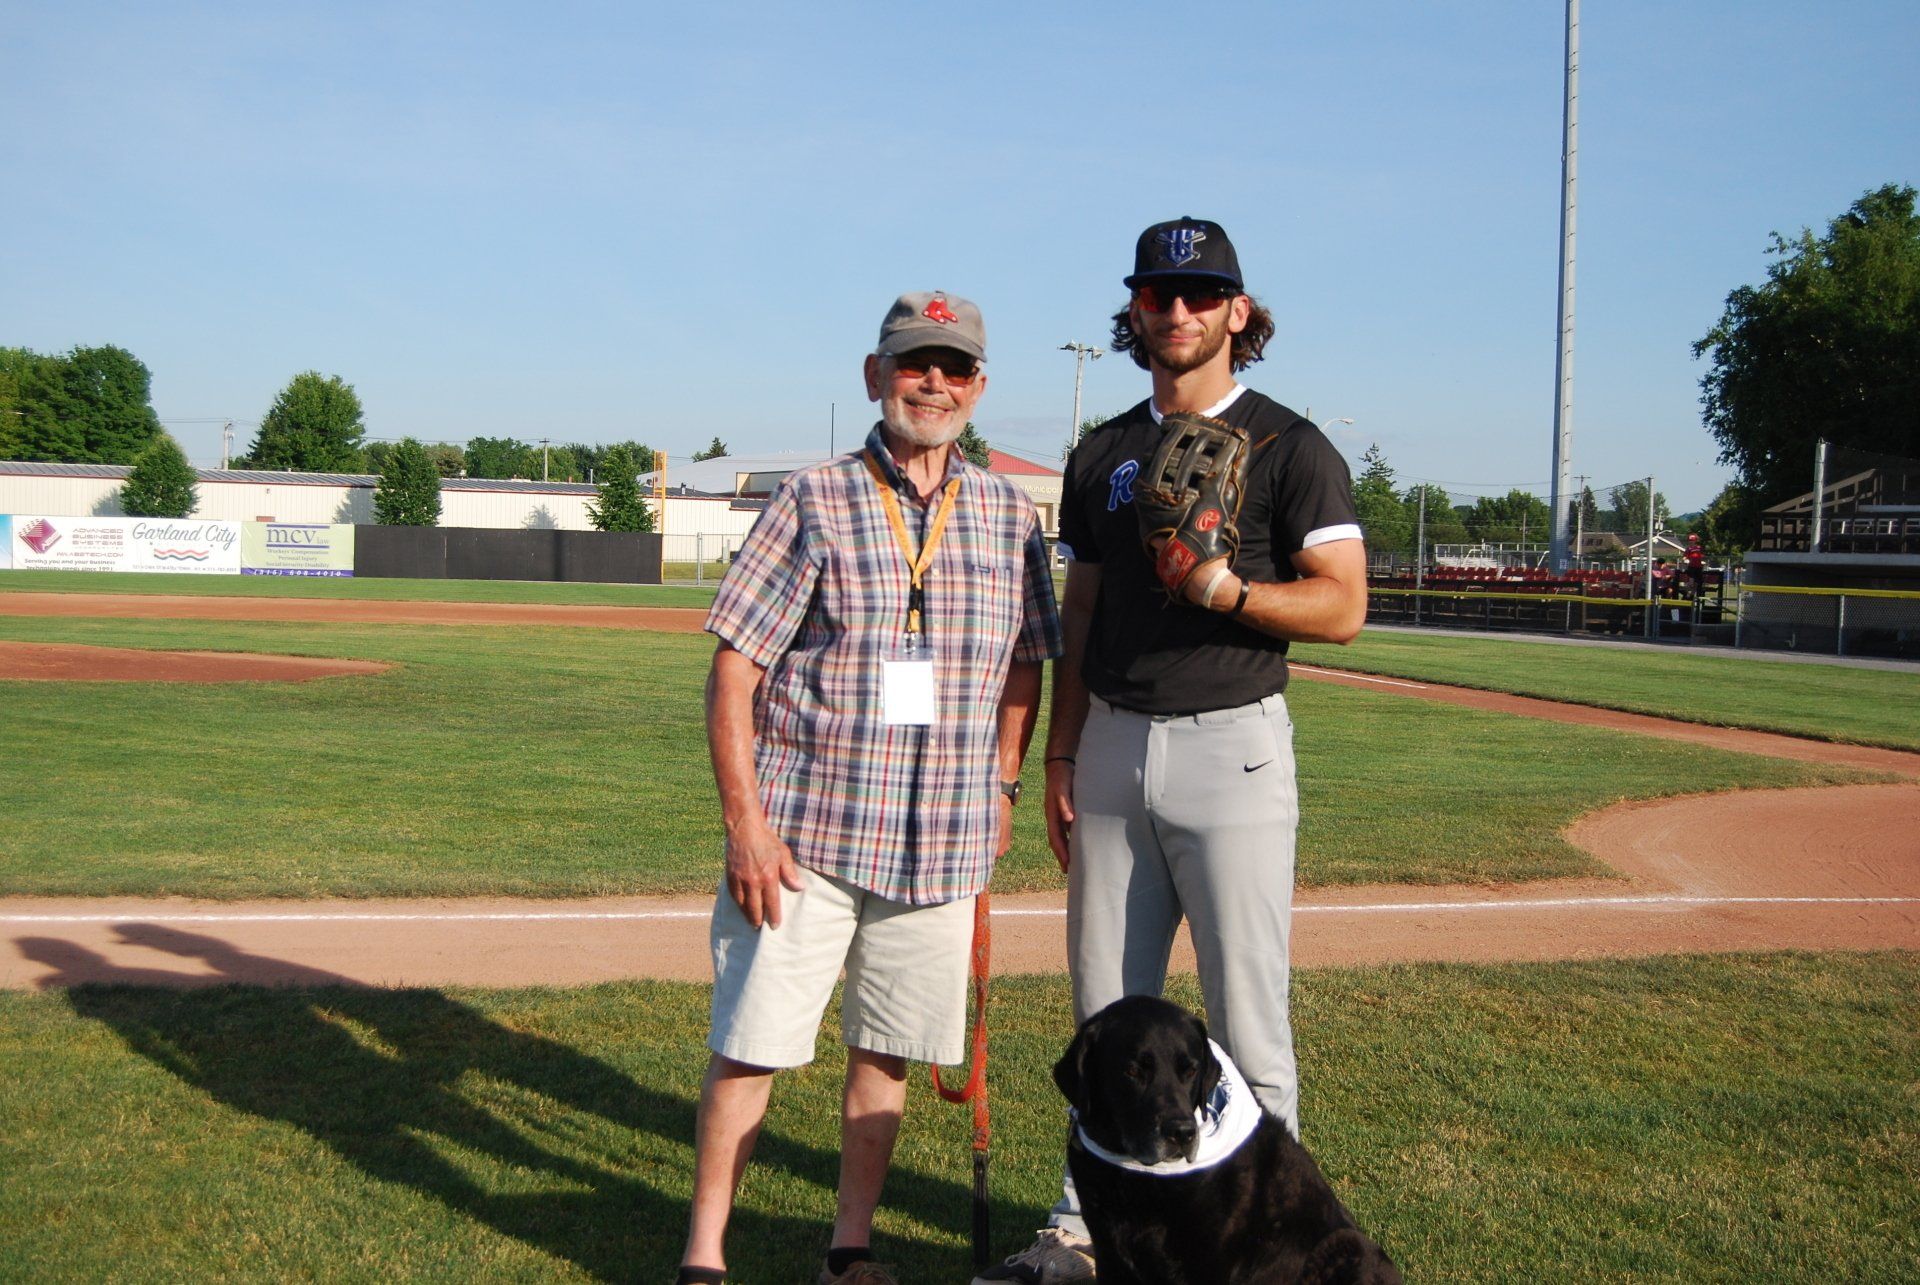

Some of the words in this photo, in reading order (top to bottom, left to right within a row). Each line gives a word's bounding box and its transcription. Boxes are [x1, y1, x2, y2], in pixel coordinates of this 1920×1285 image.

[132, 522, 203, 541] Garland
[205, 524, 237, 551] City
[267, 528, 317, 544] mcv
[317, 537, 329, 545] law
